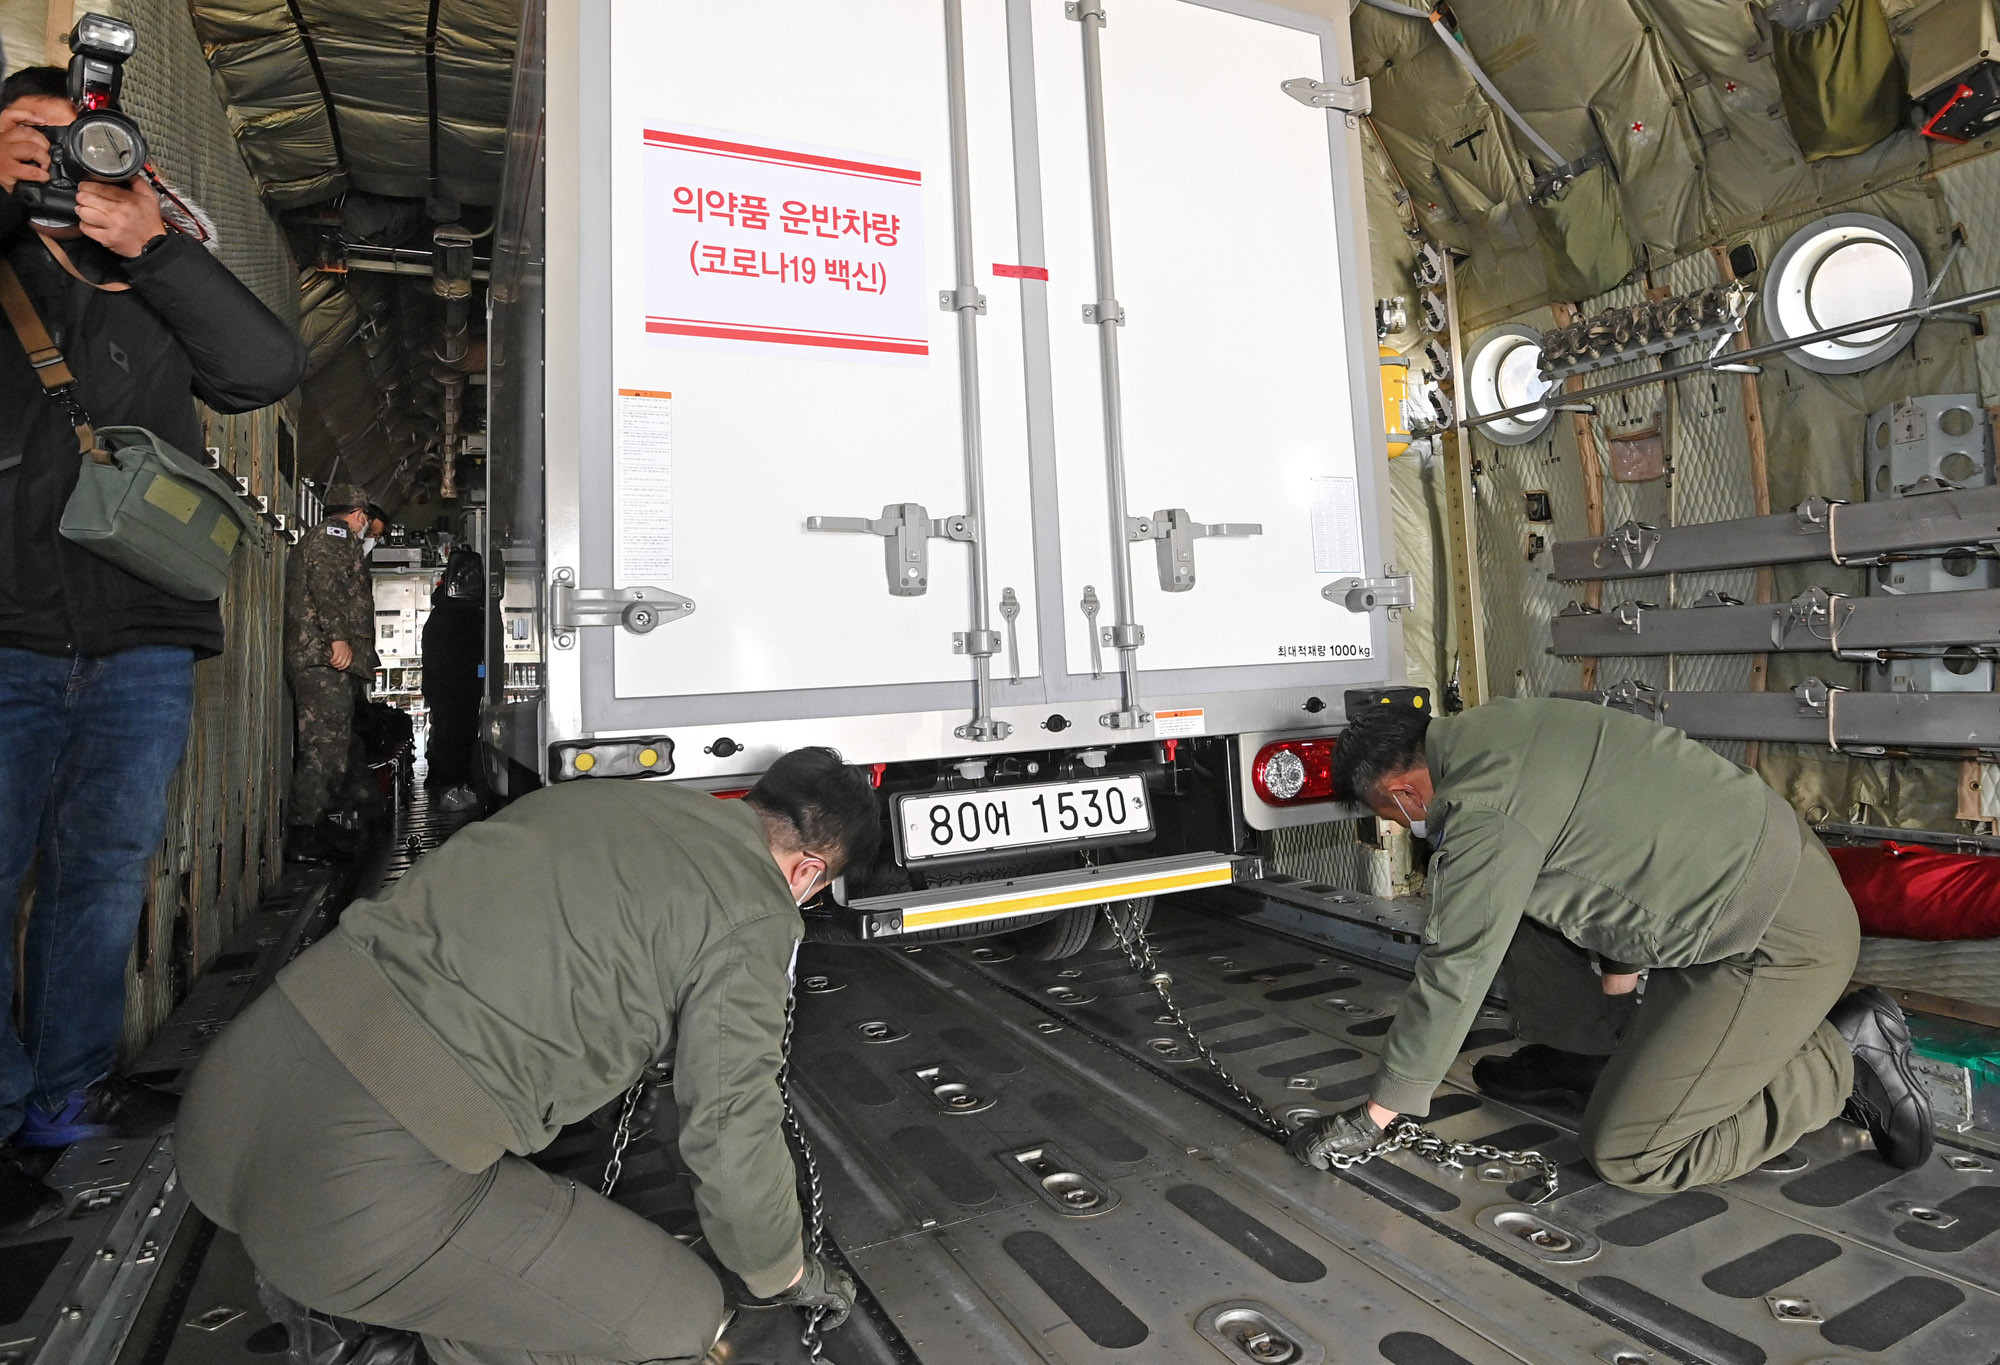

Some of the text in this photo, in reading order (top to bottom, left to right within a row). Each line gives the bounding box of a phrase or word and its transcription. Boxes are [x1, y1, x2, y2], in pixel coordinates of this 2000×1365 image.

[672, 186, 900, 247] 의약품 운반차량
[690, 240, 887, 295] (코로나19 백신)
[1278, 644, 1370, 658] 최대적재량 1000 kg
[929, 786, 1127, 846] 80어 1530
